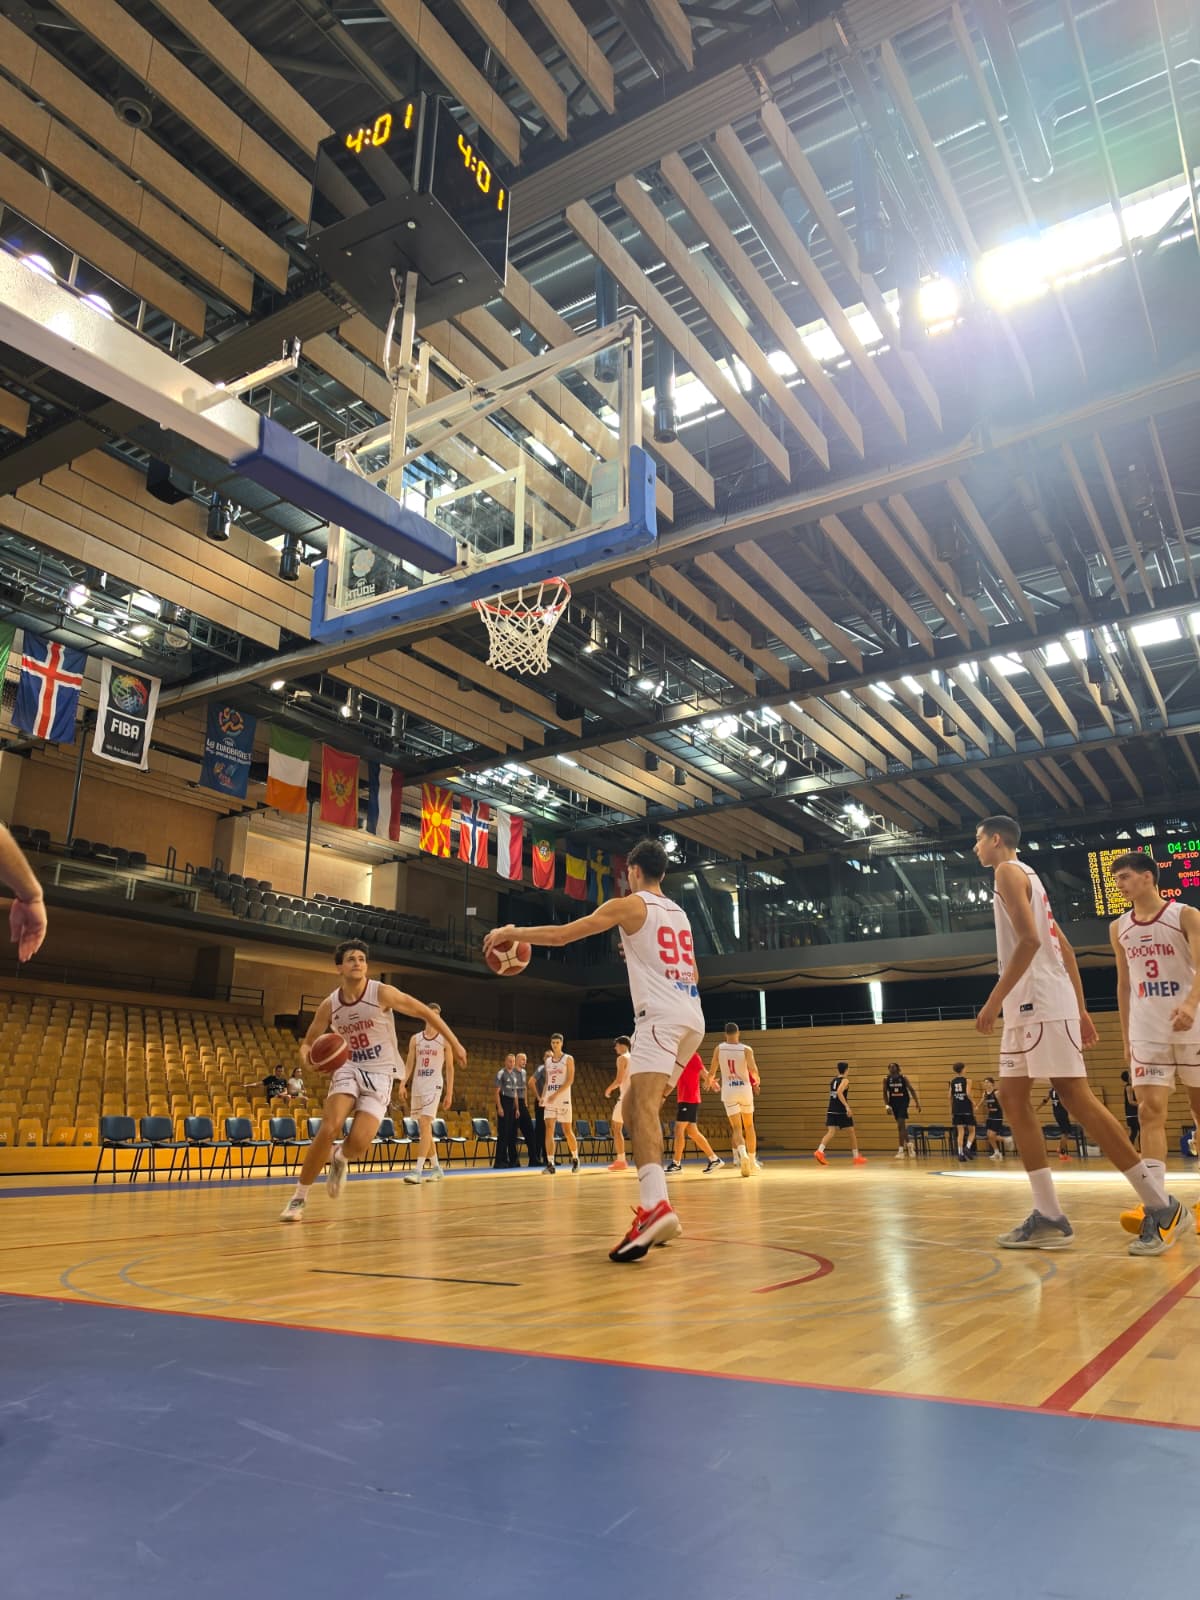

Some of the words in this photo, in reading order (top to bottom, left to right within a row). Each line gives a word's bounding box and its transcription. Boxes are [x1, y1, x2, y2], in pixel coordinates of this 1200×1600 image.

[110, 717, 140, 740] FIBA
[1167, 840, 1200, 854] 04:01
[1173, 852, 1199, 860] PERIOD
[1160, 888, 1182, 898] CRO
[657, 926, 694, 966] 99
[1127, 944, 1175, 960] CROATIA
[1145, 959, 1159, 979] 3
[338, 1019, 374, 1035] CROATIA
